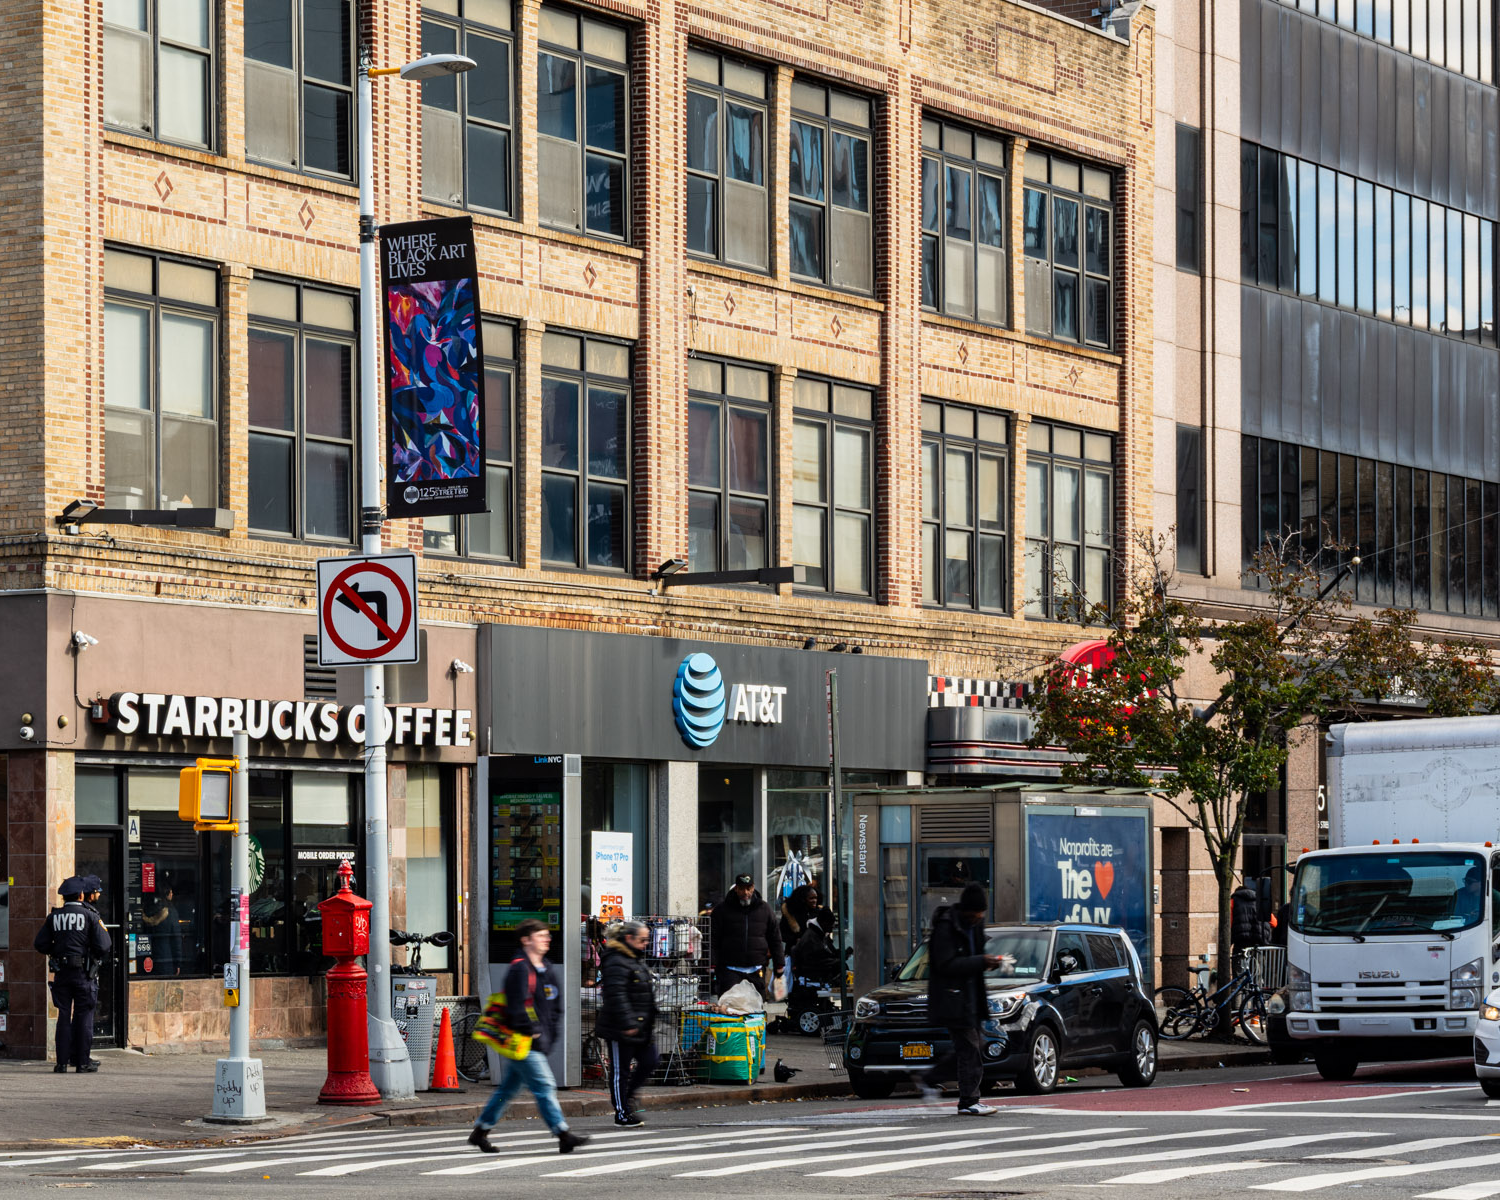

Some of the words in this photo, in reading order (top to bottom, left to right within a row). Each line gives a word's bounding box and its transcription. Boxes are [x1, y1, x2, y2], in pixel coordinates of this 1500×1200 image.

[387, 233, 437, 251] WHERE
[388, 247, 436, 265] BLACK
[439, 243, 467, 260] ART
[389, 262, 426, 279] LIVES
[729, 684, 787, 723] AT&T
[116, 692, 338, 742] STARBUCKS
[534, 756, 562, 764] LinkNYC
[130, 819, 138, 835] A
[859, 814, 868, 874] Newsstand
[1060, 837, 1099, 861] Nonprofits
[1101, 843, 1113, 857] are
[298, 852, 317, 860] MOBILE
[319, 852, 336, 860] ORDER
[336, 852, 355, 860] PICKUP
[596, 851, 613, 861] iPhone
[620, 853, 628, 862] Pro
[1058, 858, 1092, 900] The
[601, 895, 623, 904] PRO
[53, 913, 85, 931] NYPD
[1359, 970, 1400, 979] ISUZU
